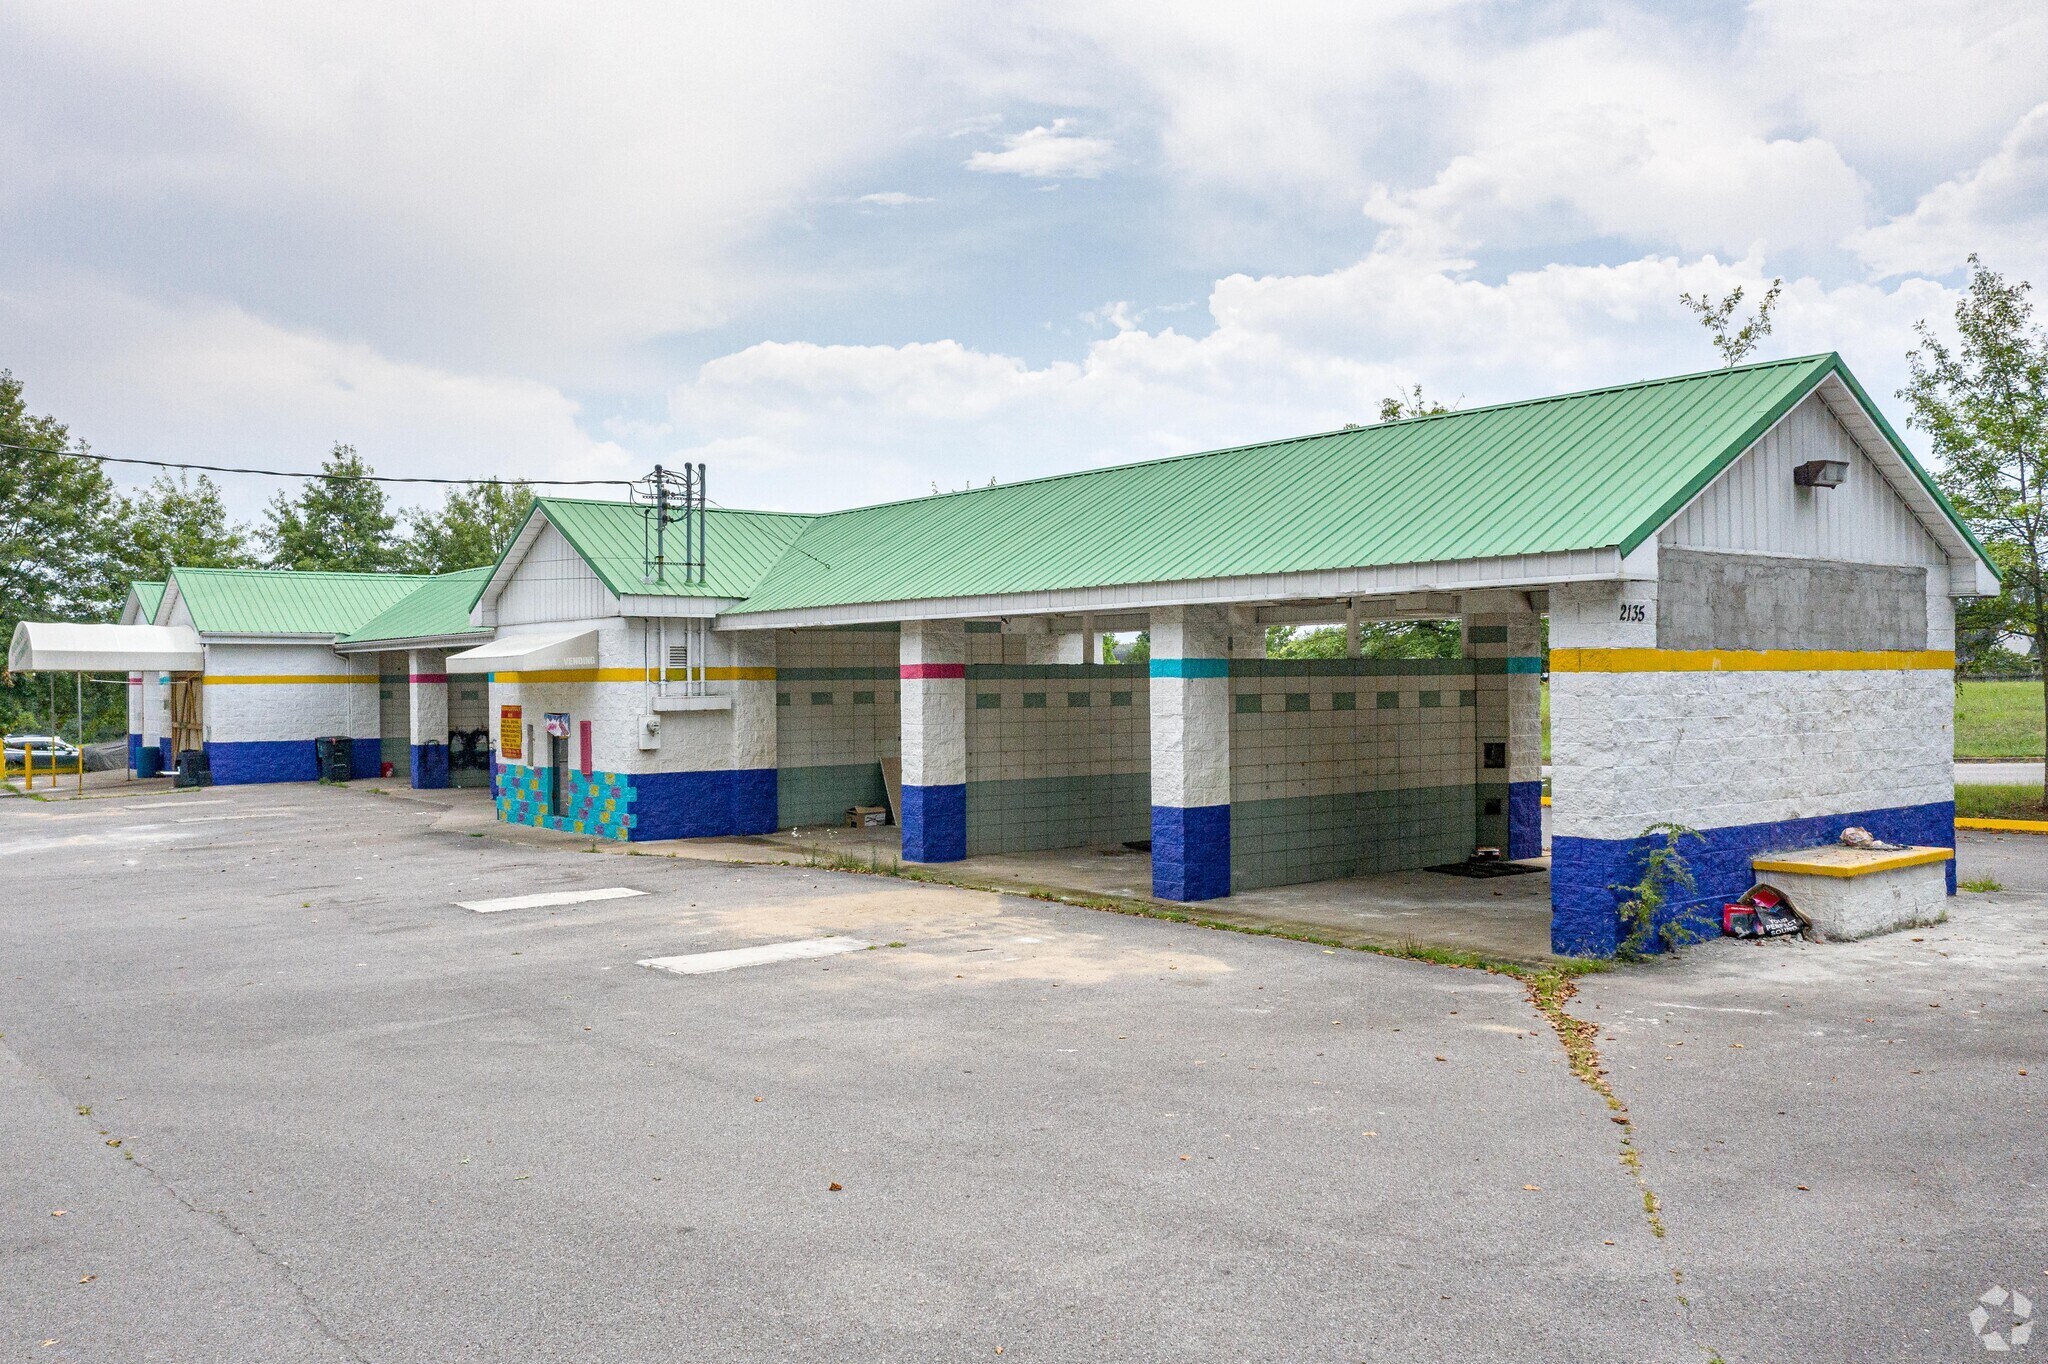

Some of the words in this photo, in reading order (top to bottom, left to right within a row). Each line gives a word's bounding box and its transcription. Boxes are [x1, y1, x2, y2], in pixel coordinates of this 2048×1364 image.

[1620, 604, 1645, 621] 2135
[563, 656, 596, 666] VENDING
[1765, 918, 1797, 931] PERFECT
[1768, 917, 1789, 925] YOUR
[1770, 925, 1798, 936] SOUND
